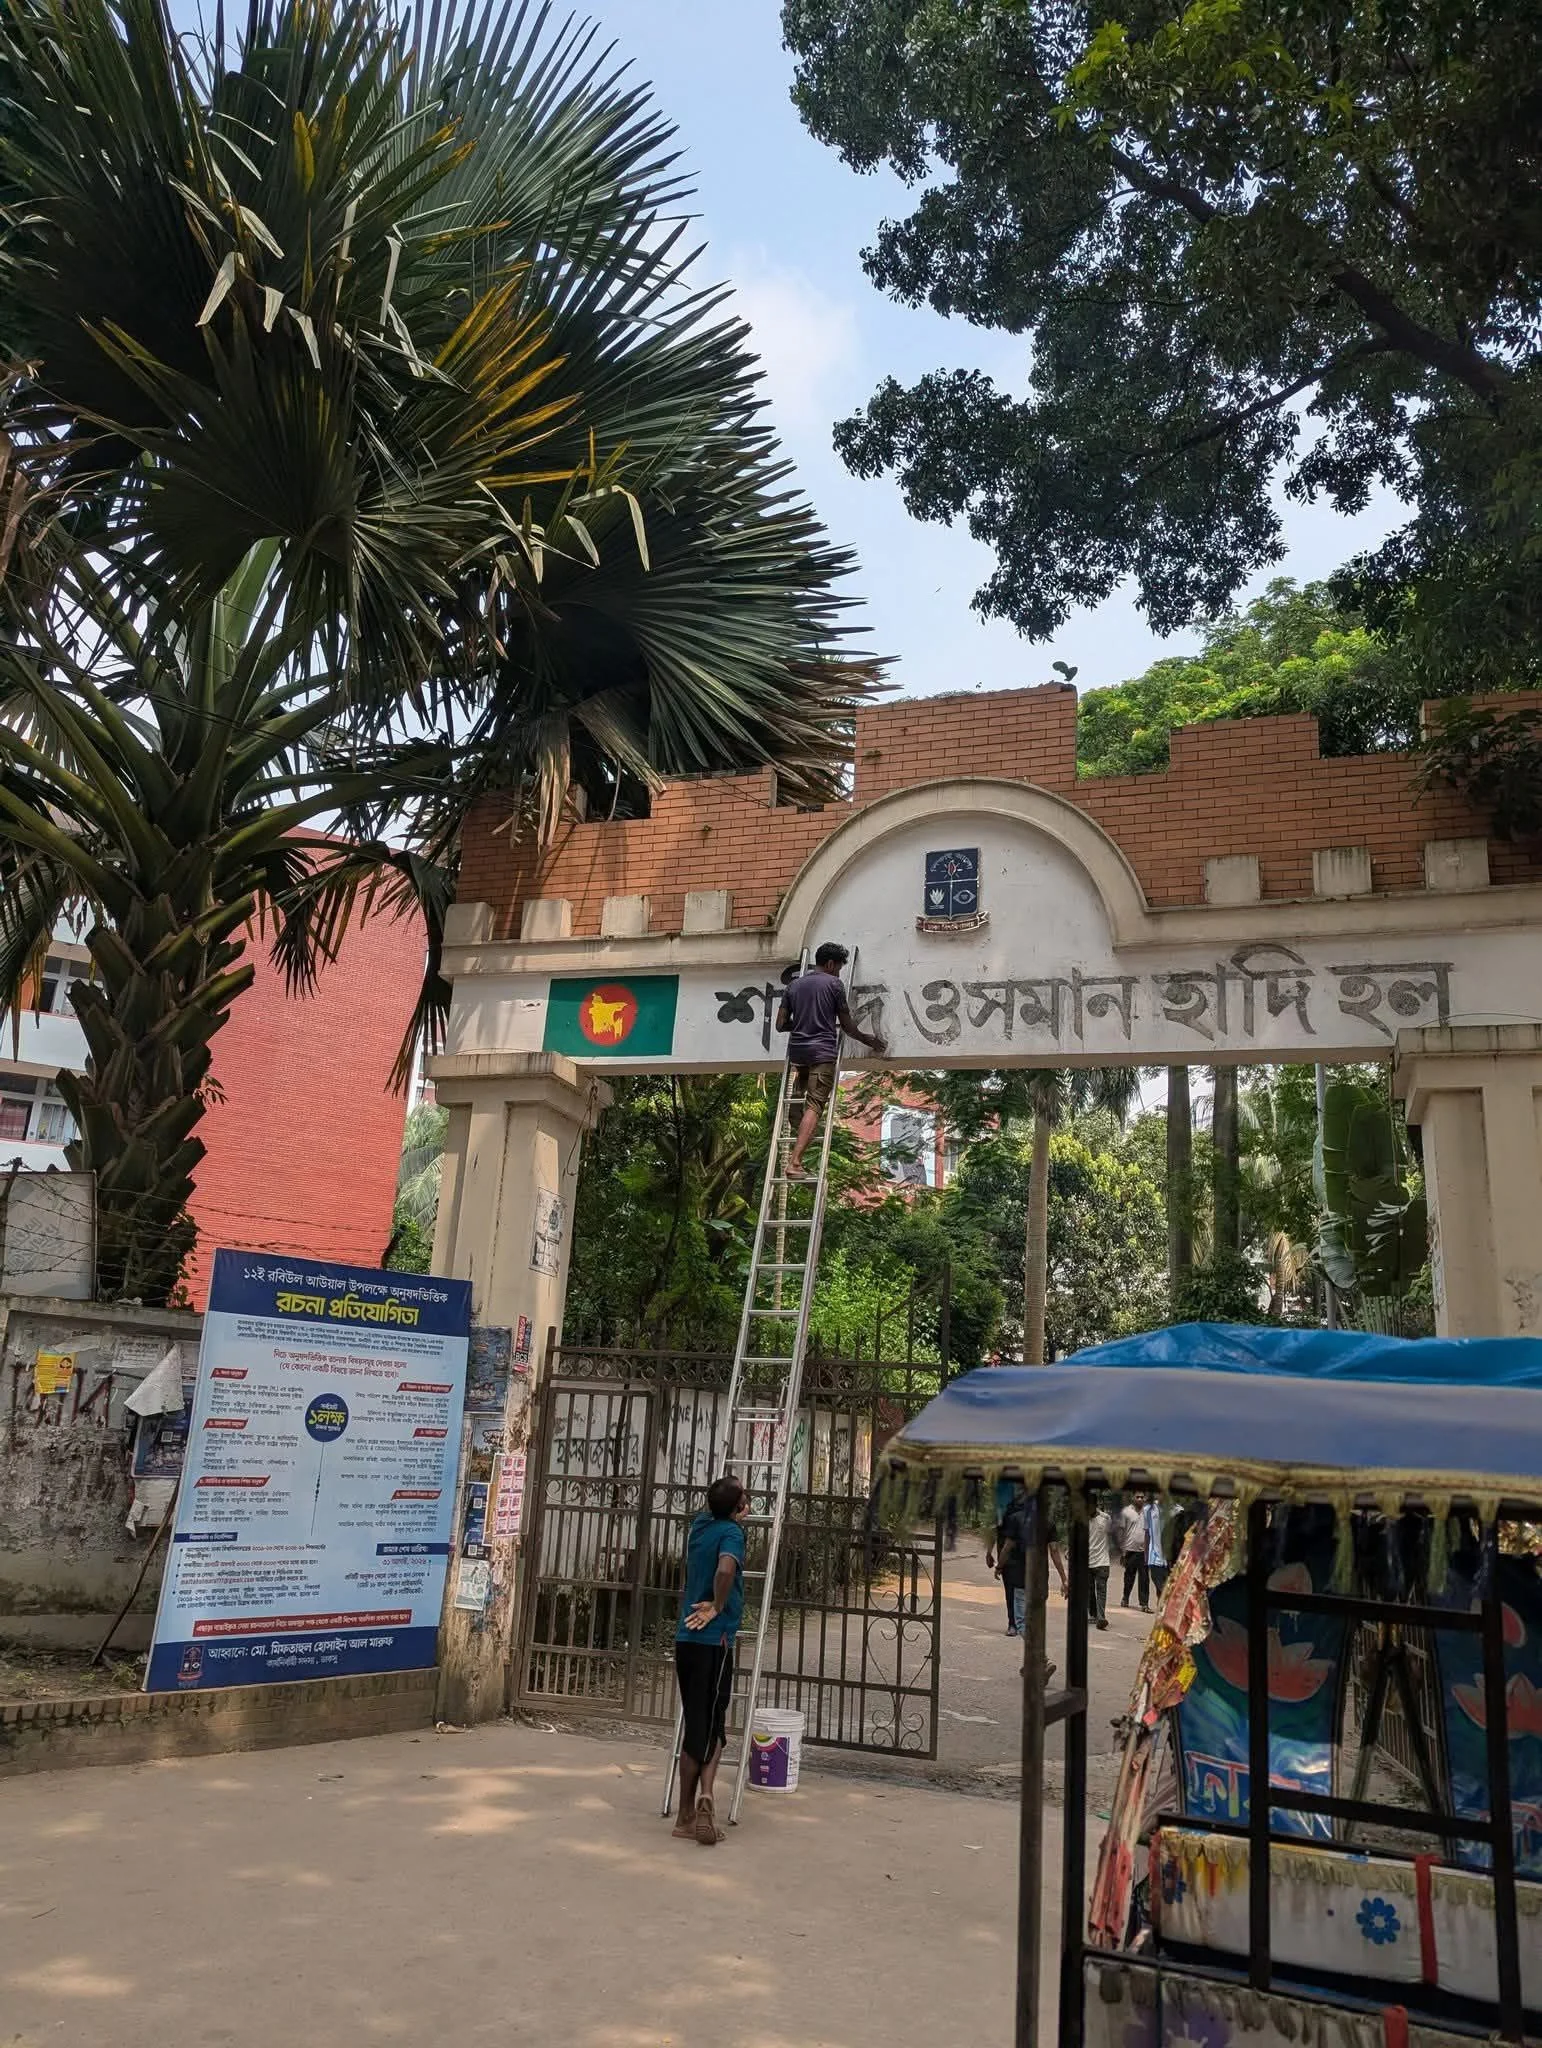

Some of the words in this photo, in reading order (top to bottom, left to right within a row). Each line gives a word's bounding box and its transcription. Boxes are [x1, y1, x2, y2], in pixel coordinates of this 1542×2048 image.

[903, 965, 1141, 1047] ওসমান
[1151, 943, 1319, 1042] হাদি
[1325, 962, 1455, 1040] হল
[243, 1266, 266, 1283] ১২ই
[267, 1268, 303, 1286] রবিউল
[305, 1274, 347, 1292] আউয়াল
[349, 1278, 389, 1298] উপলক্ষে
[390, 1286, 449, 1304] অনুষদভিত্তিক
[276, 1291, 326, 1317] রচনা
[328, 1294, 420, 1327] প্রতিযোগিতা
[349, 1638, 369, 1649] আল
